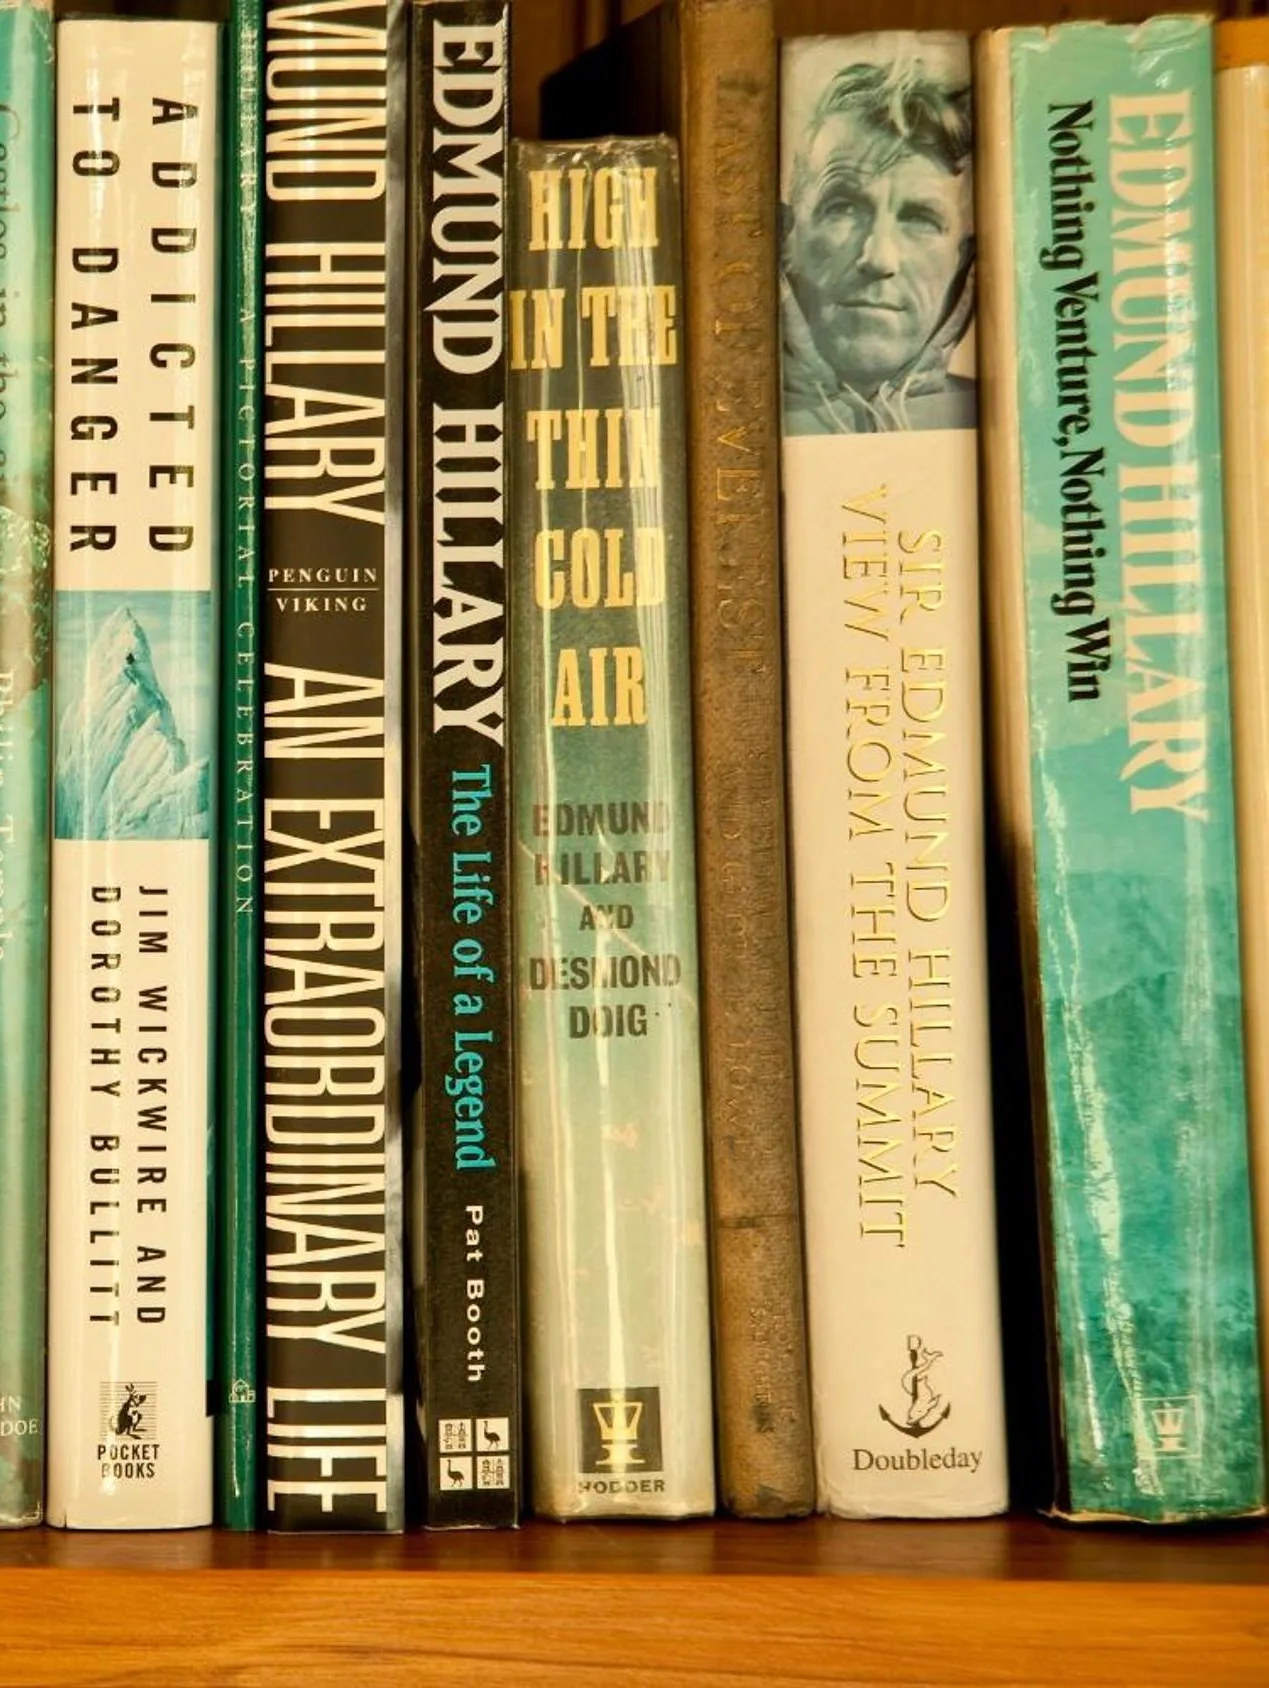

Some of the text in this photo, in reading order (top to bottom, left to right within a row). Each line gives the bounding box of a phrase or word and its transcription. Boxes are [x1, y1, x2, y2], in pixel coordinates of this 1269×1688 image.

[528, 166, 659, 251] HIGH
[1038, 98, 1098, 273] Nothing
[68, 96, 121, 553] TO DANGER
[147, 96, 199, 554] ADDICTED
[239, 308, 257, 326] A
[509, 285, 679, 370] IN THE
[264, 242, 387, 525] HILLARY
[424, 18, 506, 747] EDMUND HILLARY
[237, 358, 257, 589] PICTORIAL
[526, 407, 661, 490] THIN
[1107, 92, 1212, 824] EDMUND HILLARY
[534, 527, 666, 610] COLD
[1051, 447, 1110, 617] Nothing
[268, 568, 378, 583] PENGUIN
[276, 596, 368, 613] VIKING
[550, 646, 648, 728] AIR
[1064, 616, 1112, 702] Win
[236, 622, 257, 914] CELEBRATION
[532, 801, 670, 837] EDMUND
[534, 850, 671, 886] HILLARY
[841, 482, 909, 1249] VIEW FROM THE SUMMIT
[898, 527, 960, 1199] SIR EDMUND HILLARY
[579, 903, 634, 930] AND
[444, 763, 497, 1174] The Life of a Legend
[529, 955, 682, 991] DESMOND
[568, 1003, 648, 1039] DOIG
[89, 886, 122, 1327] DOROTHY BULLITT
[135, 886, 169, 1325] JIM WICKWIRE AND
[264, 662, 388, 1514] AN EXTRAORDINARY LIFE
[464, 1204, 486, 1383] Pat Booth
[97, 1444, 161, 1460] POCKET
[101, 1462, 156, 1479] BOOKS
[852, 1446, 984, 1472] Doubleday
